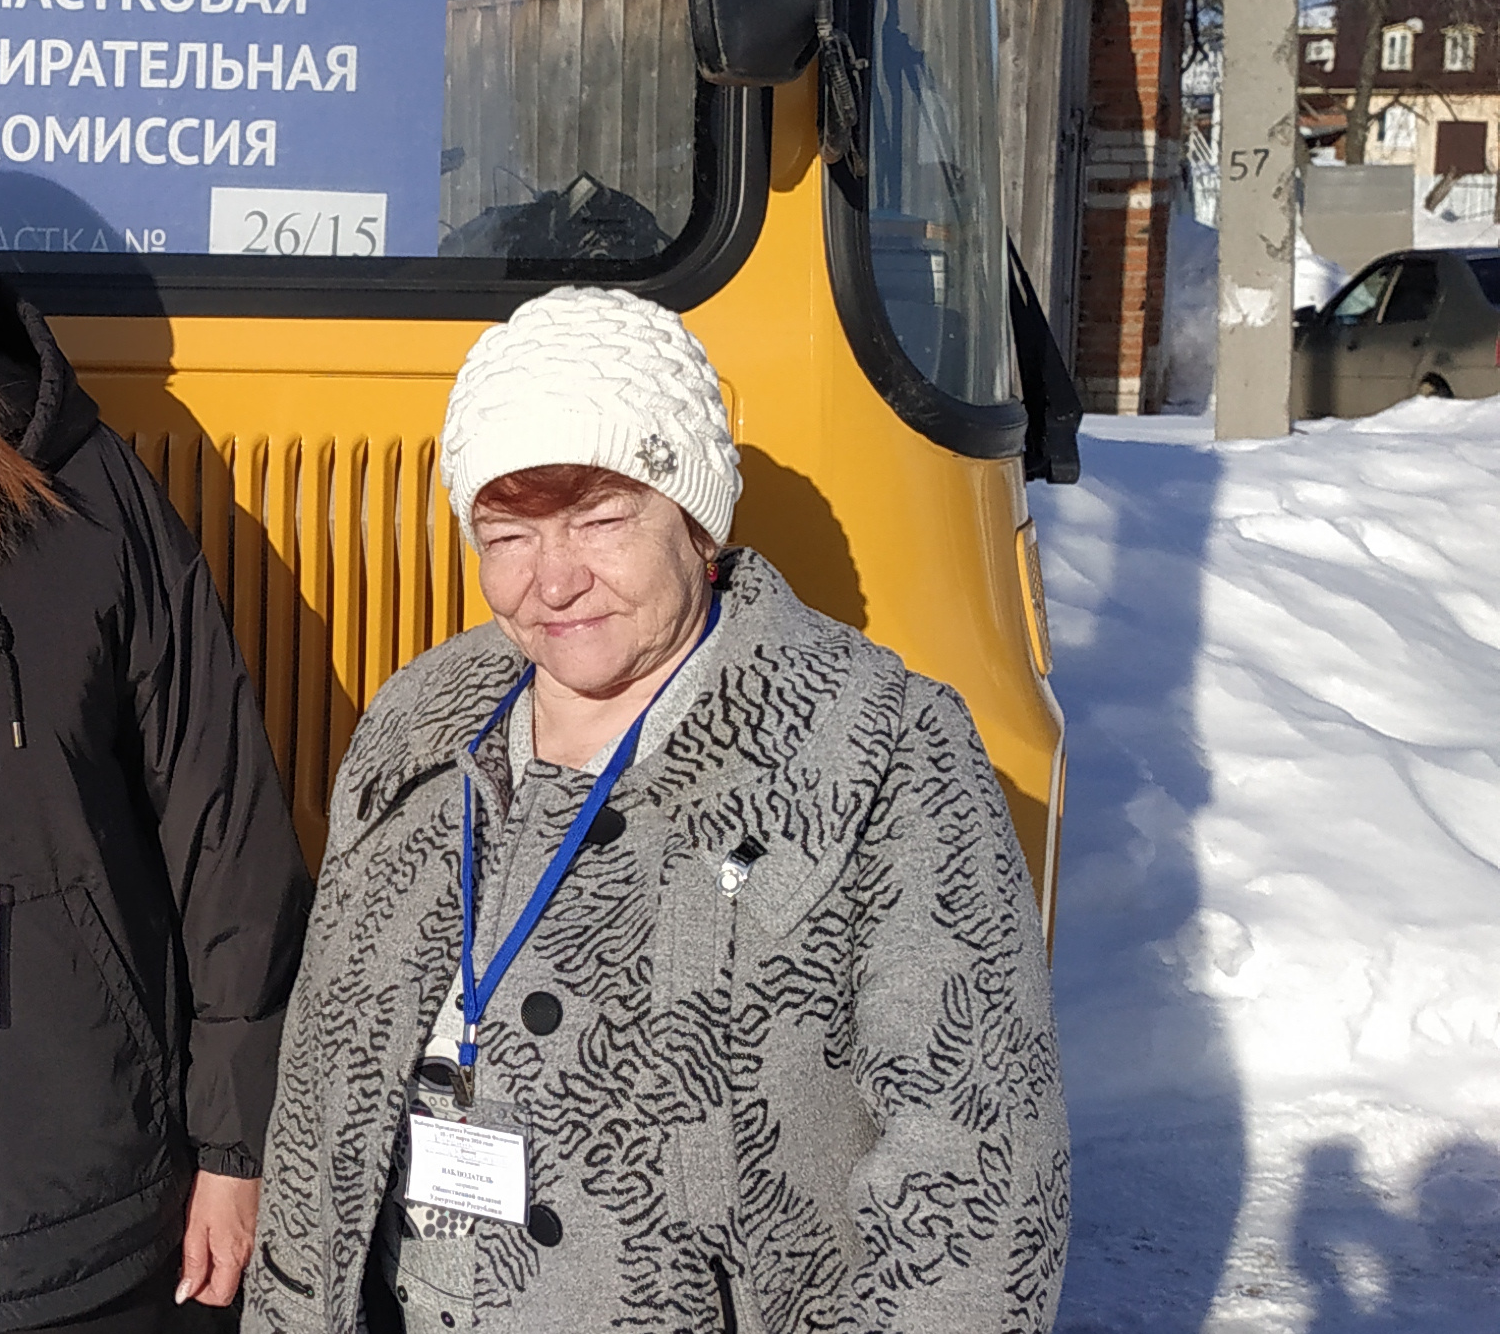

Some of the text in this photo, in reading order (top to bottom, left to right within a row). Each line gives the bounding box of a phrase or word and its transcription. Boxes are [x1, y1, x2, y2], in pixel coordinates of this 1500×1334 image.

[1229, 148, 1270, 181] 57
[125, 227, 167, 254] №
[241, 209, 380, 257] 26/15
